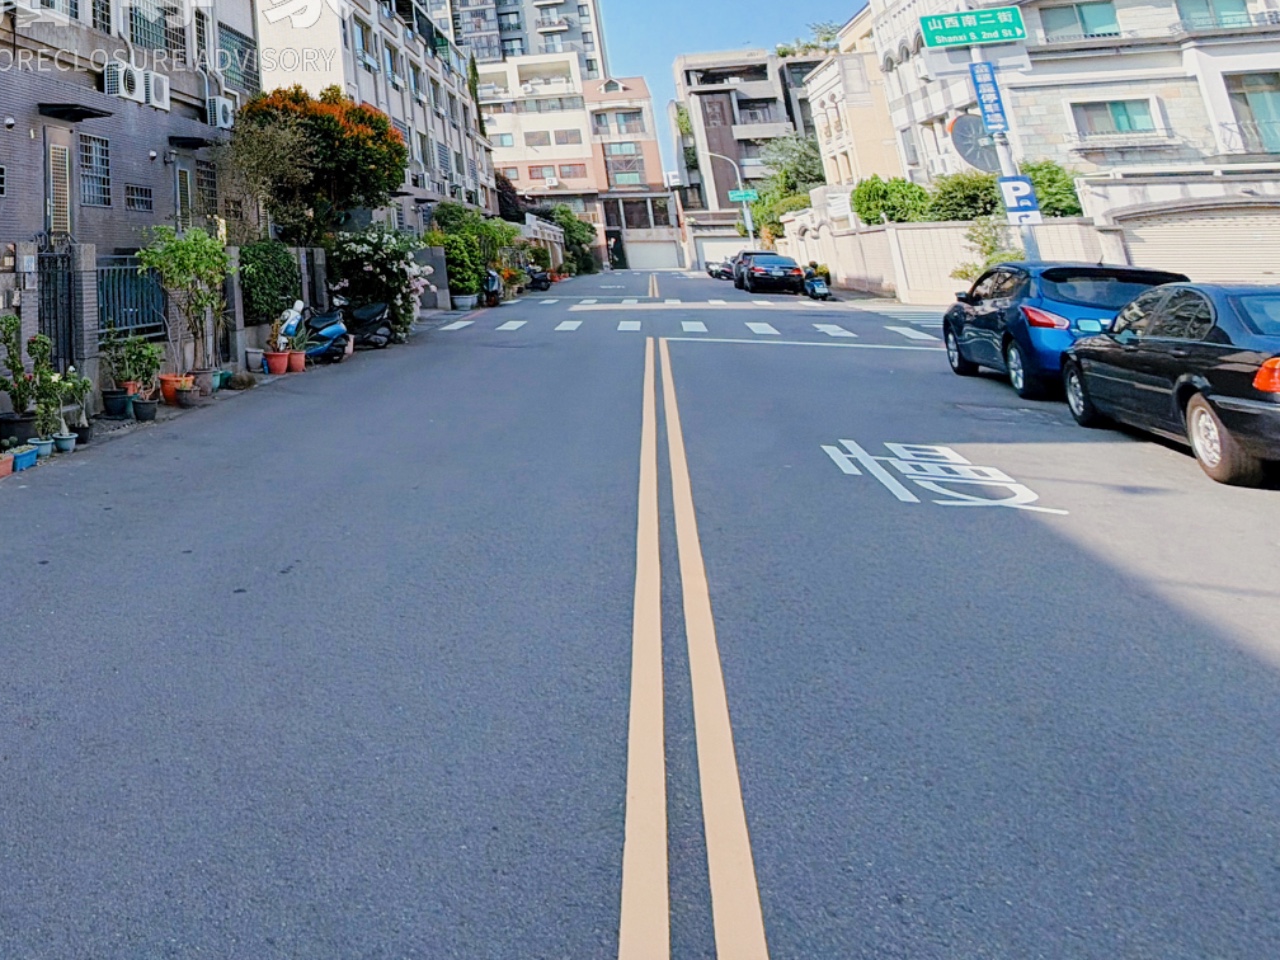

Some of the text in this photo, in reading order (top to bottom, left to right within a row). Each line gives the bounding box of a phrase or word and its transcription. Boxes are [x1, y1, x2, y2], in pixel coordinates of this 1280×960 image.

[927, 11, 1013, 31] 山西南二街
[935, 33, 967, 44] Shanxi
[969, 31, 978, 40] S.
[981, 30, 999, 39] 2nd
[1000, 181, 1032, 208] P
[820, 438, 1070, 516] 慢
